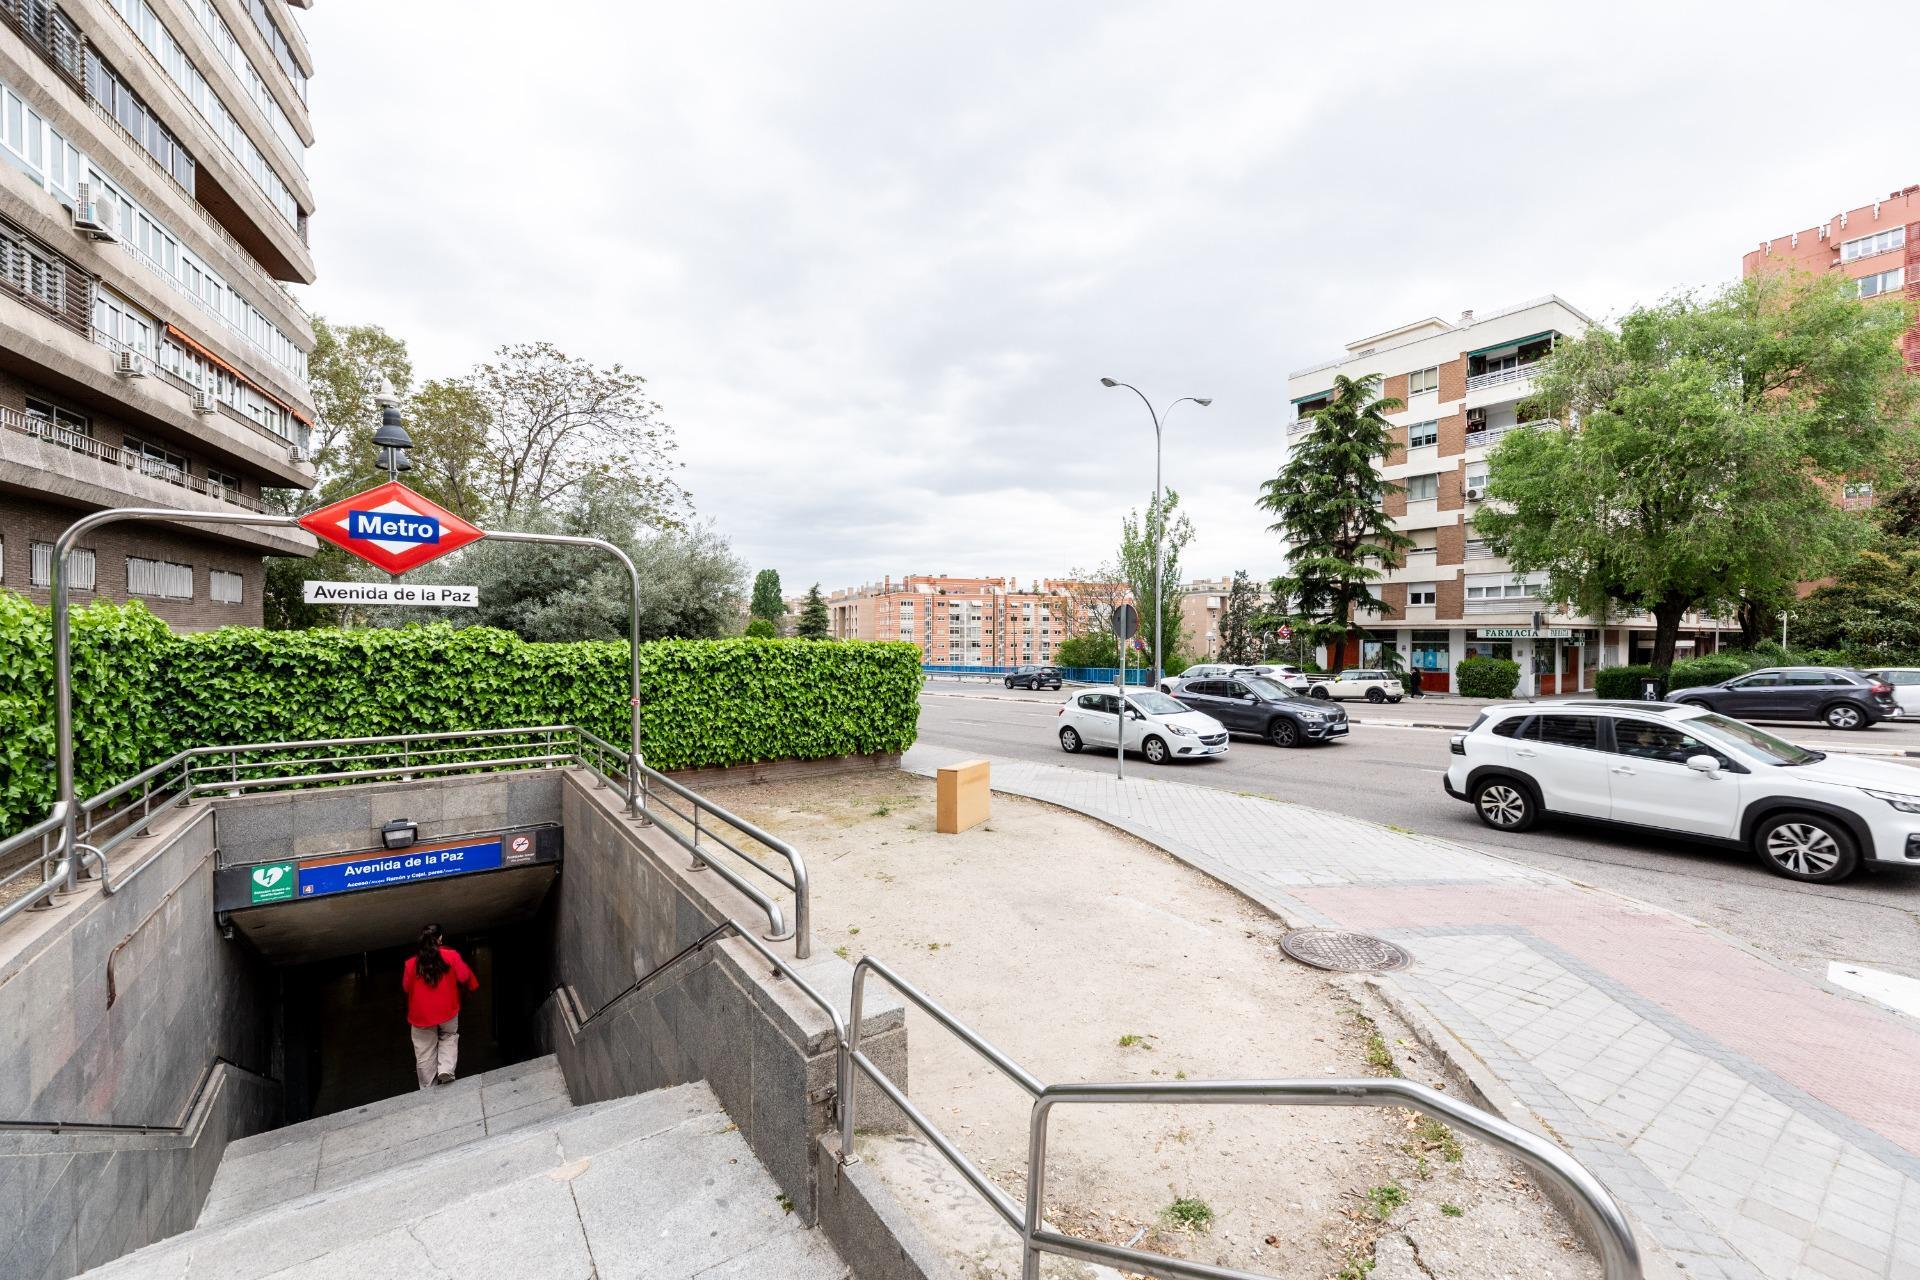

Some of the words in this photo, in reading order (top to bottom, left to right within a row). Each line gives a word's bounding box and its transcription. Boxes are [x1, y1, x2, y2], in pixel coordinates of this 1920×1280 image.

[358, 515, 433, 538] Metro
[314, 585, 388, 600] Avenida
[394, 588, 416, 601] de
[421, 589, 436, 601] la
[441, 589, 471, 602] Paz
[1485, 629, 1539, 637] FARMACIA
[344, 860, 401, 876] Avenida
[405, 857, 422, 868] de
[425, 855, 437, 865] la
[441, 852, 464, 863] Paz
